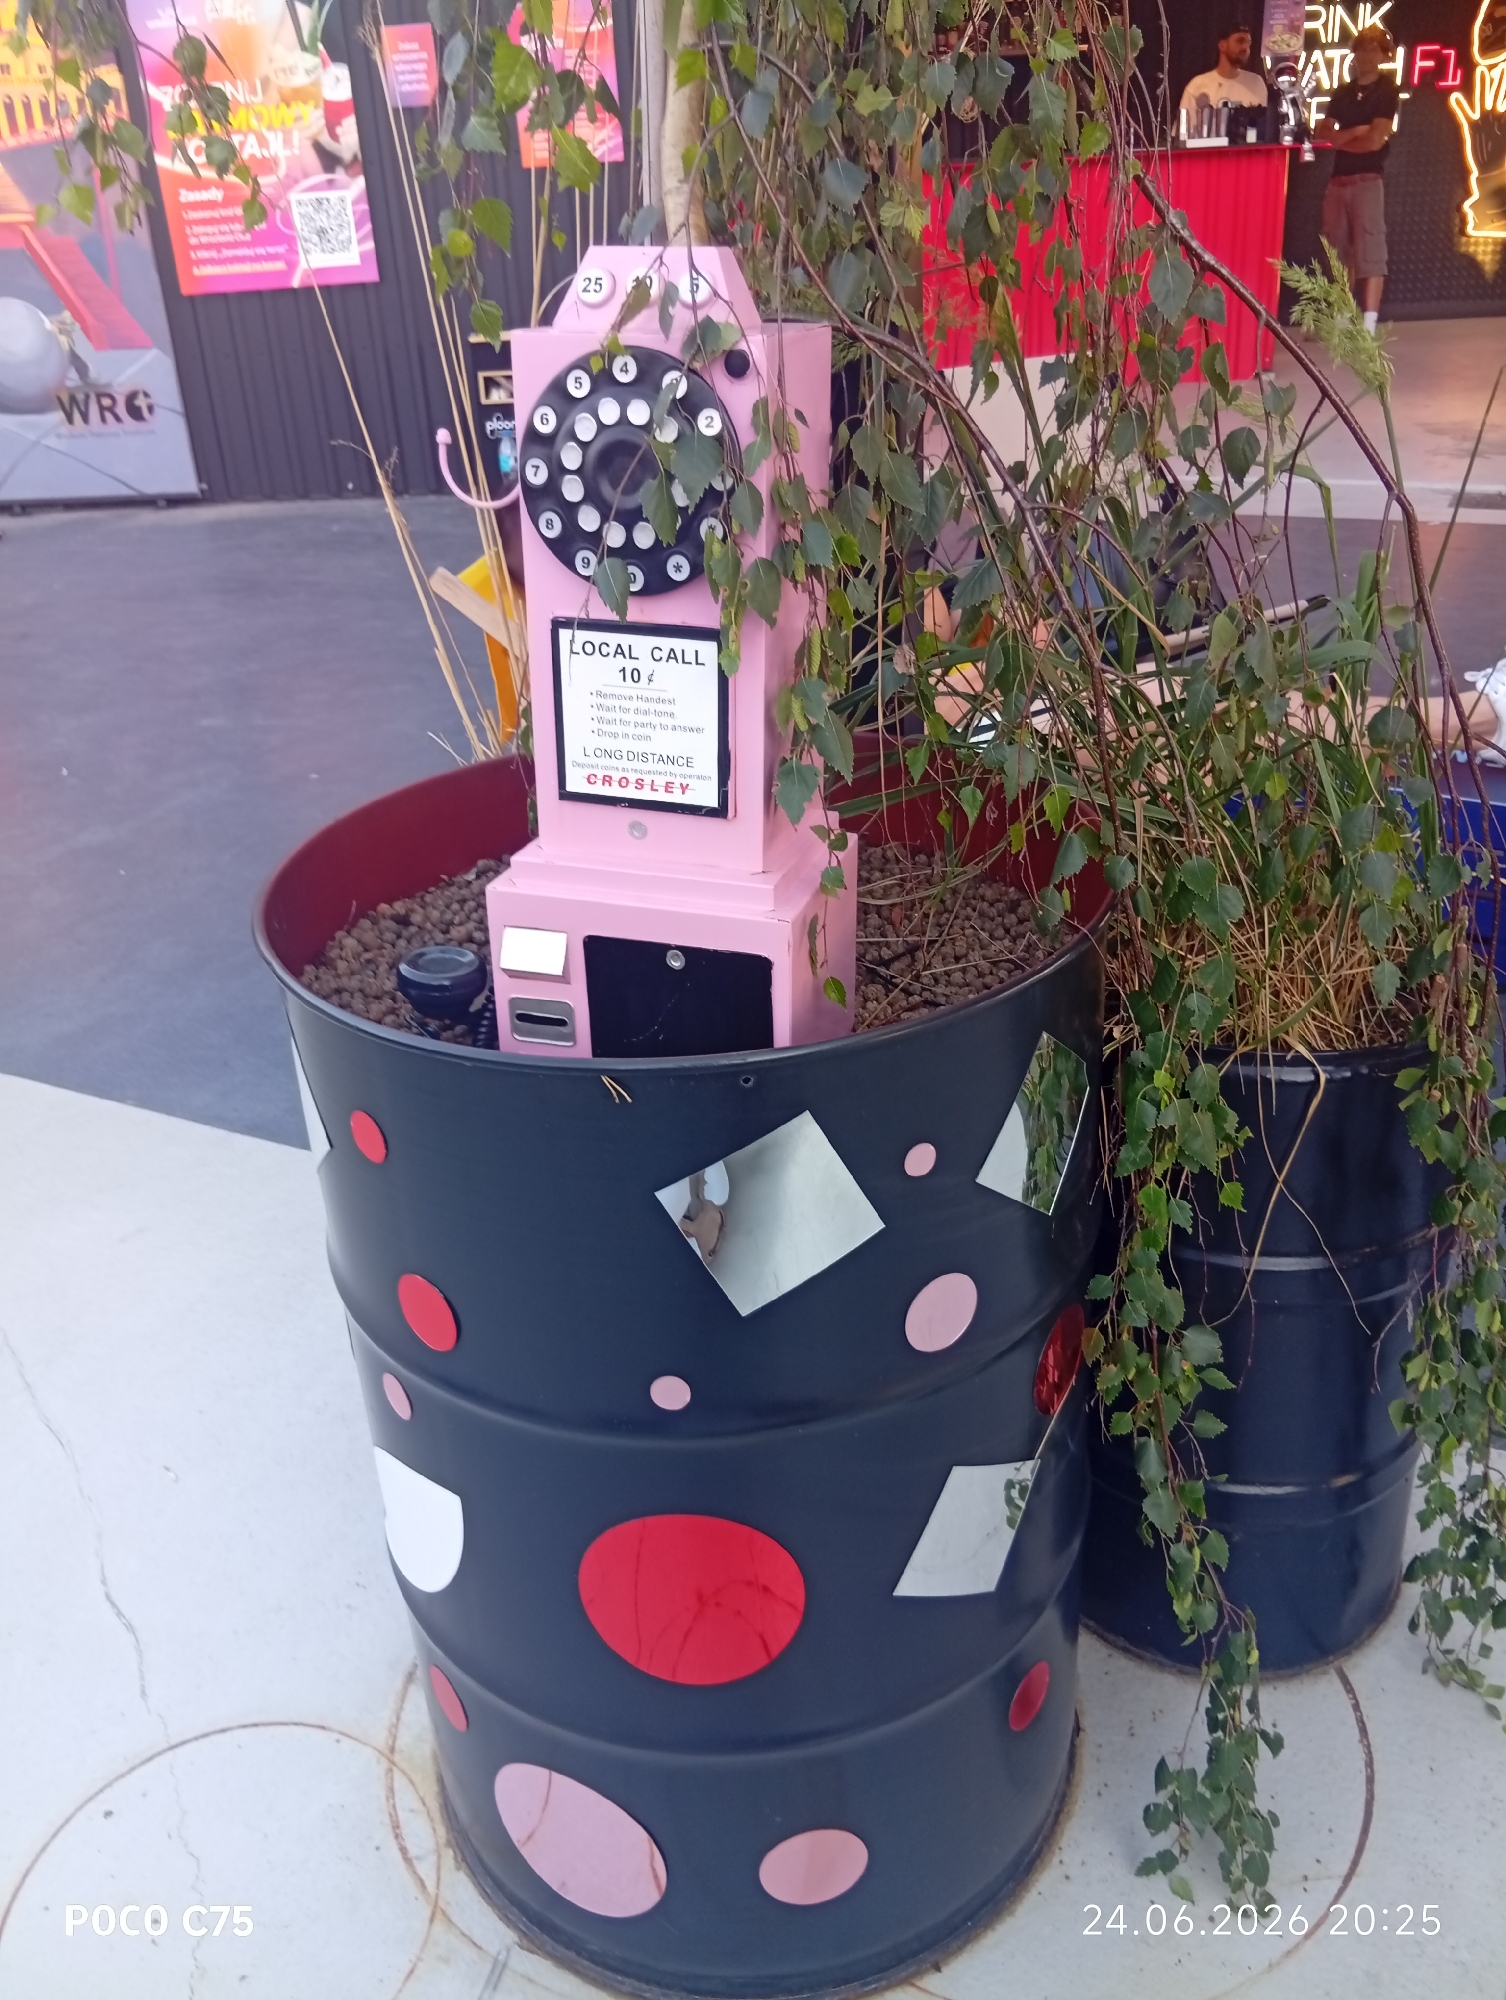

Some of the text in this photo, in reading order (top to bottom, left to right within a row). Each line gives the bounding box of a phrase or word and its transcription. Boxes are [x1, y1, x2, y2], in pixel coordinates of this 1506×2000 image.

[1304, 1, 1393, 43] RINK
[1413, 45, 1462, 86] F1
[581, 277, 603, 293] 25
[619, 361, 629, 376] 4
[573, 376, 583, 390] 5
[540, 412, 550, 426] 6
[704, 415, 715, 428] 2
[531, 464, 541, 477] 7
[545, 518, 555, 531] 8
[581, 556, 591, 569] 9
[570, 639, 706, 666] LOCAL CALL
[618, 666, 641, 684] 10
[595, 689, 676, 705] Remove Handest
[596, 702, 617, 713] Wait
[619, 704, 631, 714] for
[596, 715, 705, 734] Wait for party to answer
[597, 728, 652, 742] Drop in coin
[583, 746, 694, 768] LONG DISTANCE
[571, 760, 599, 770] Deposit
[600, 764, 620, 772] coins
[630, 767, 668, 776] requested
[586, 773, 690, 795] CROSLEY
